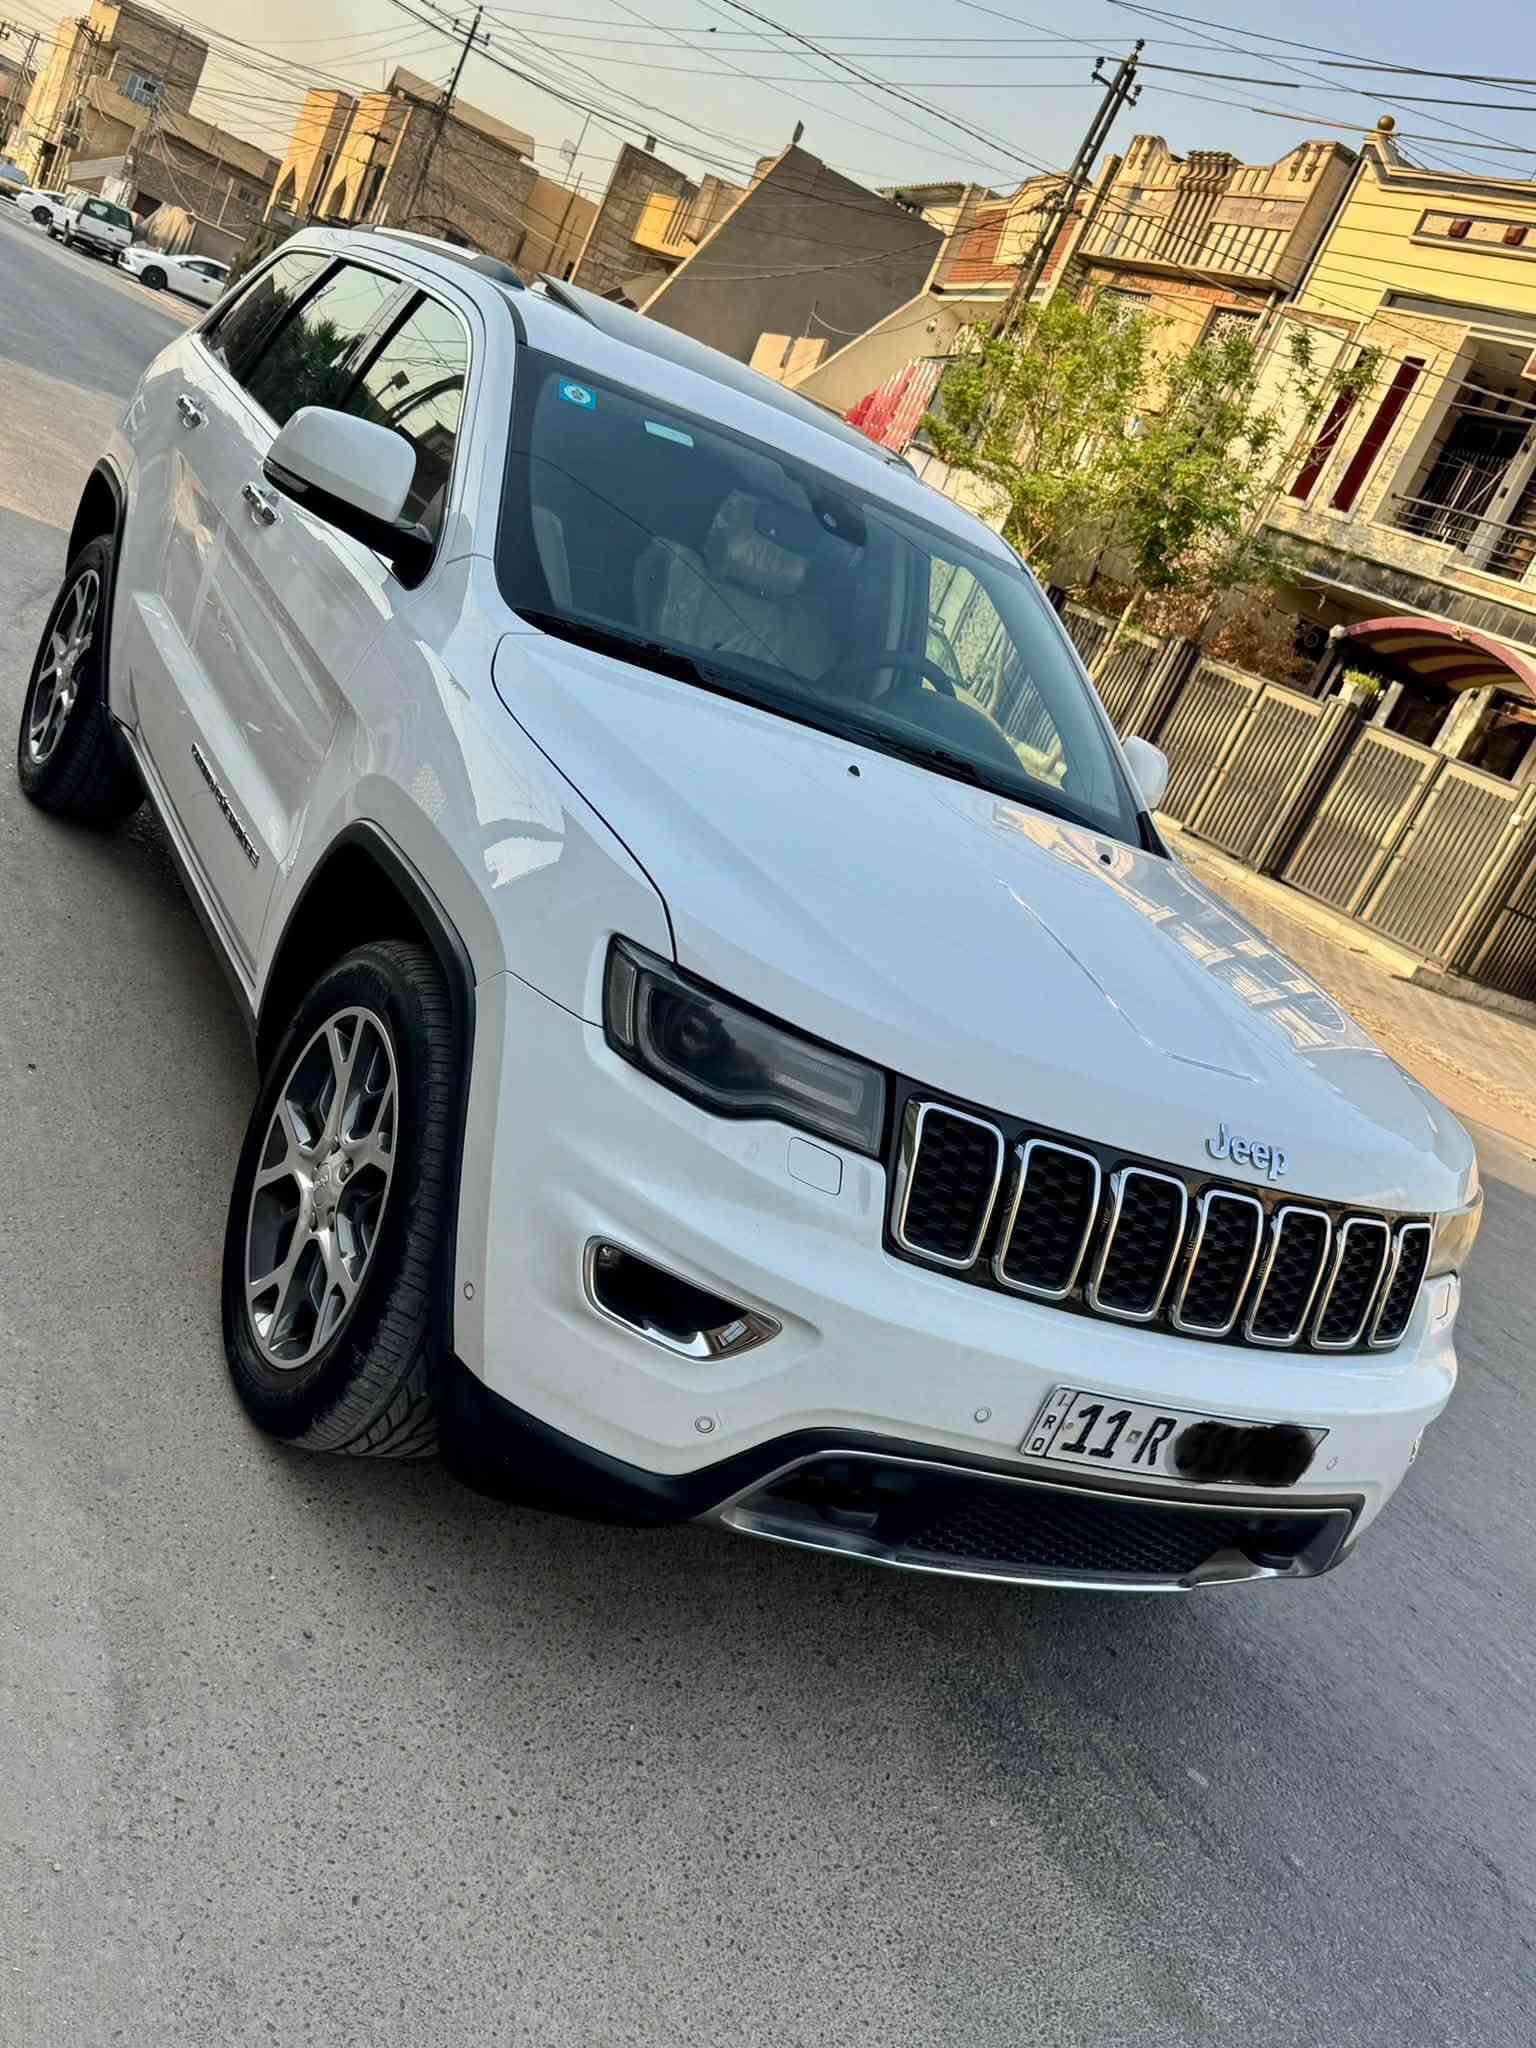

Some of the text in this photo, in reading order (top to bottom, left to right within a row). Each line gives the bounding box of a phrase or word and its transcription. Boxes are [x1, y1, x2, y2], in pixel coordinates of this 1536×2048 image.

[1204, 1122, 1288, 1182] Jeep
[1061, 1403, 1133, 1460] 11
[1131, 1416, 1178, 1466] R
